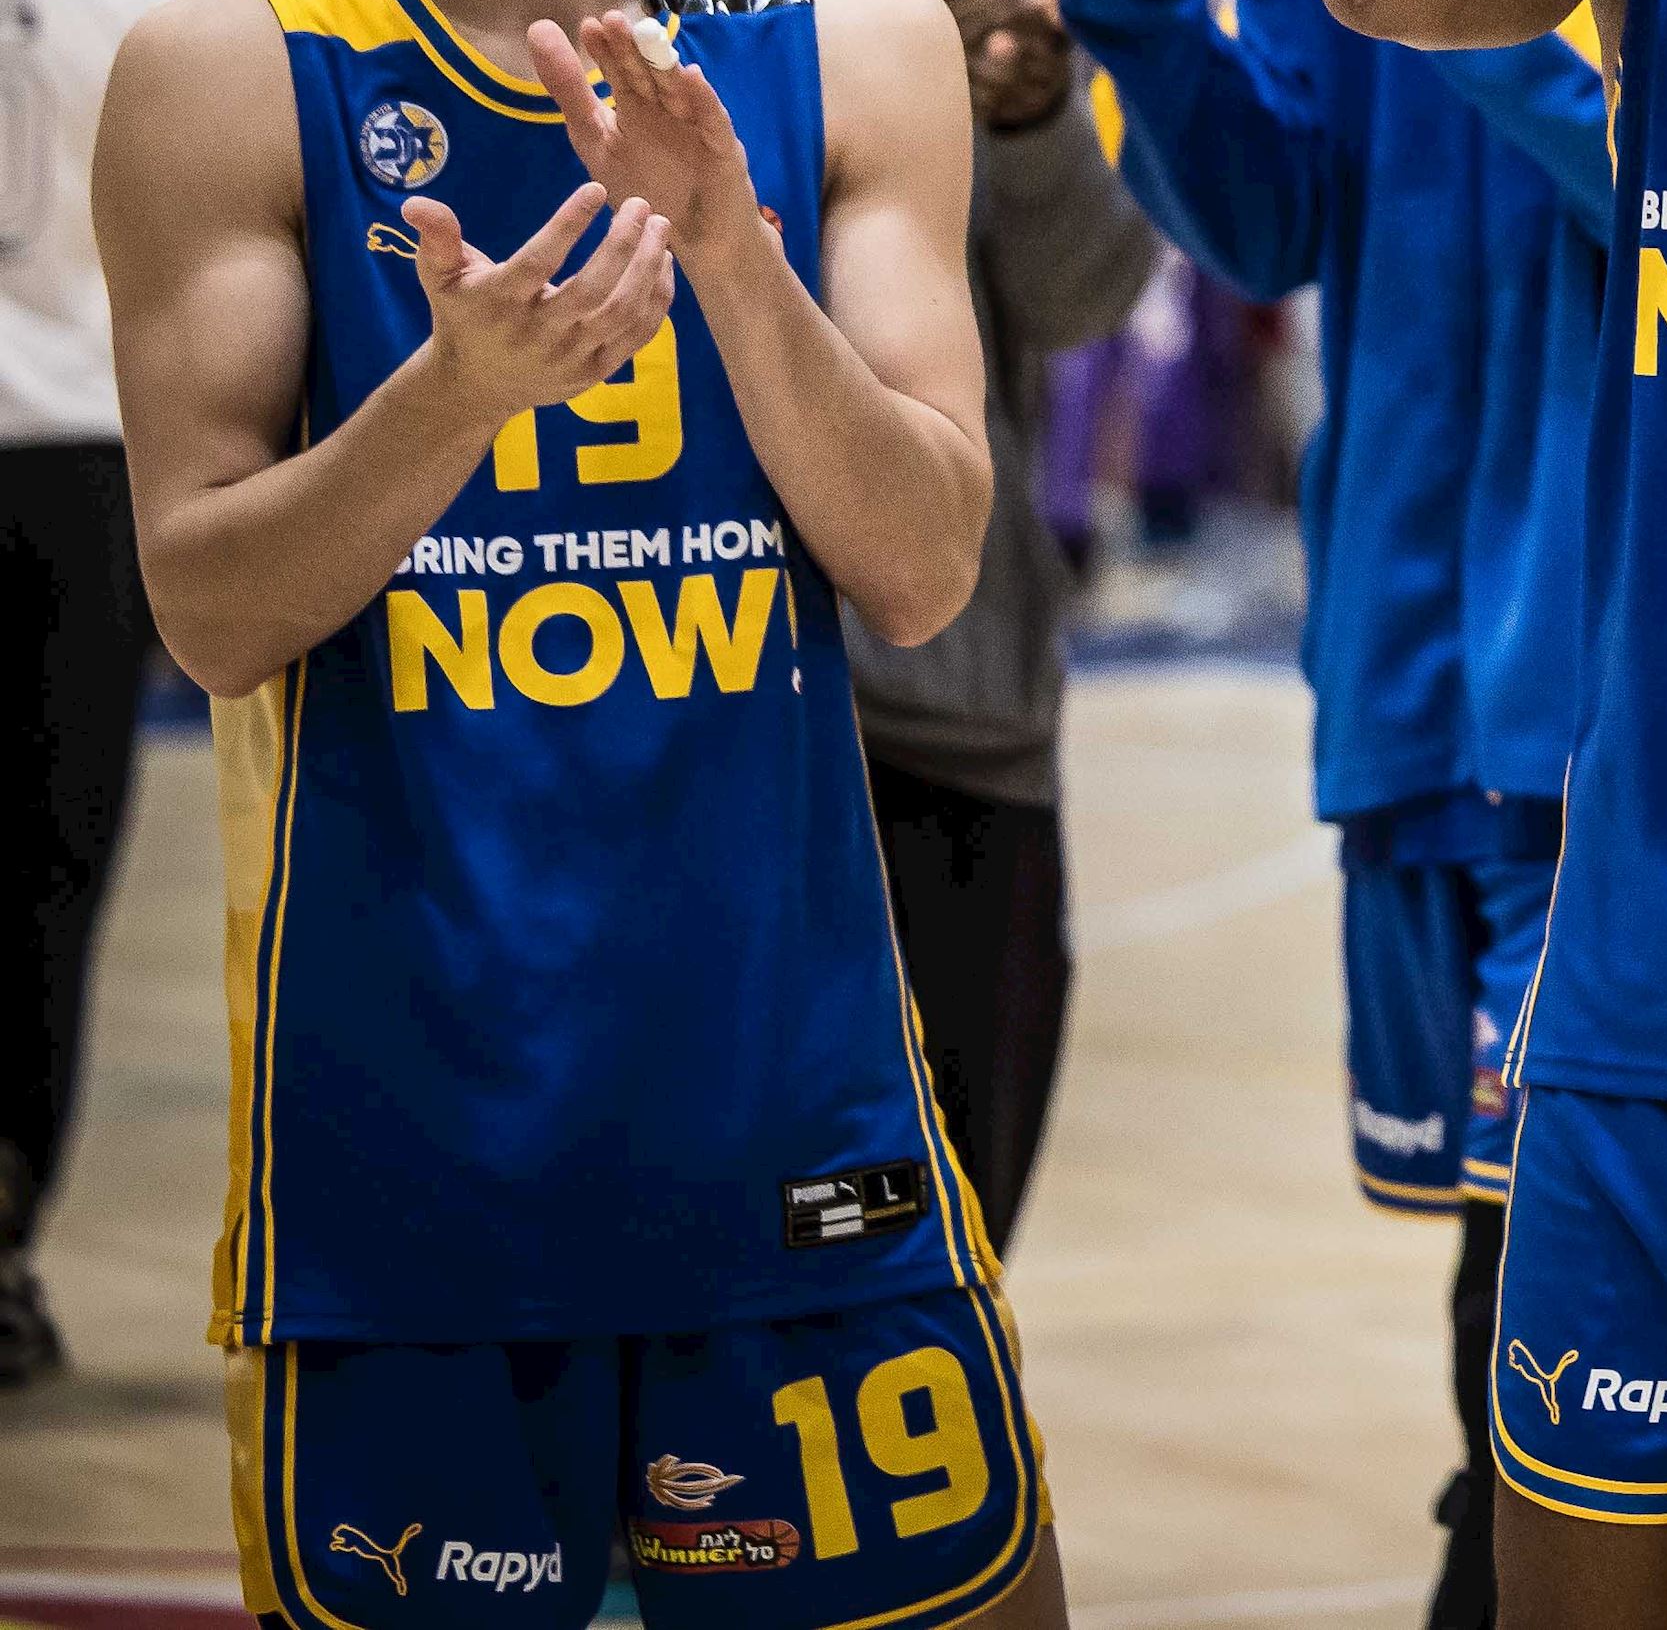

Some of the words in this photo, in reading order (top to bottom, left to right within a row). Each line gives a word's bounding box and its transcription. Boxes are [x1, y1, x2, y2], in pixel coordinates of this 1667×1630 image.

[393, 534, 525, 576] RING
[532, 526, 672, 572] THEM
[680, 518, 786, 564] HOM
[385, 567, 799, 713] NOW
[881, 1173, 900, 1202] L
[772, 1345, 991, 1561] 19
[436, 1541, 562, 1592] Rapyd
